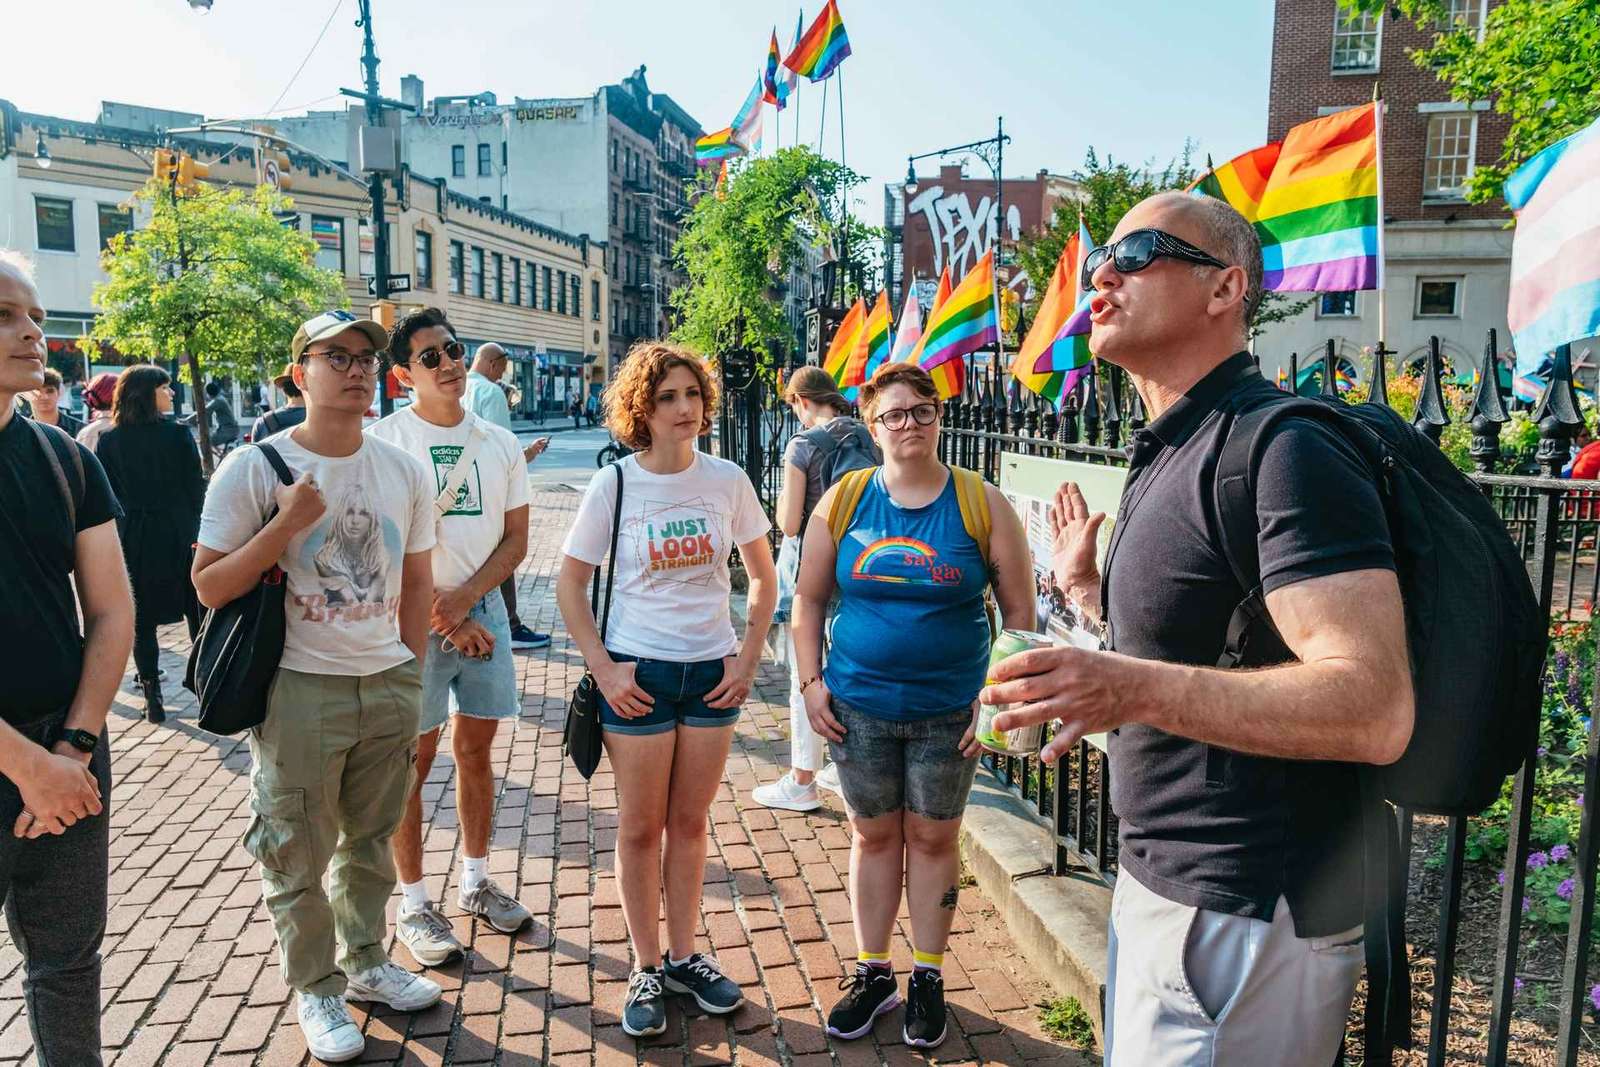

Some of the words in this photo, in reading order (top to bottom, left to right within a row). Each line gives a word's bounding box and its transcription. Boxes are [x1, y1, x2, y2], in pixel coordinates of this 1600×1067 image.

[432, 447, 460, 455] adidas
[647, 523, 654, 540] I
[660, 517, 707, 538] JUST
[648, 534, 715, 561] LOOK
[651, 555, 713, 571] STRAIGHT
[903, 553, 935, 573] say
[931, 564, 962, 584] gay
